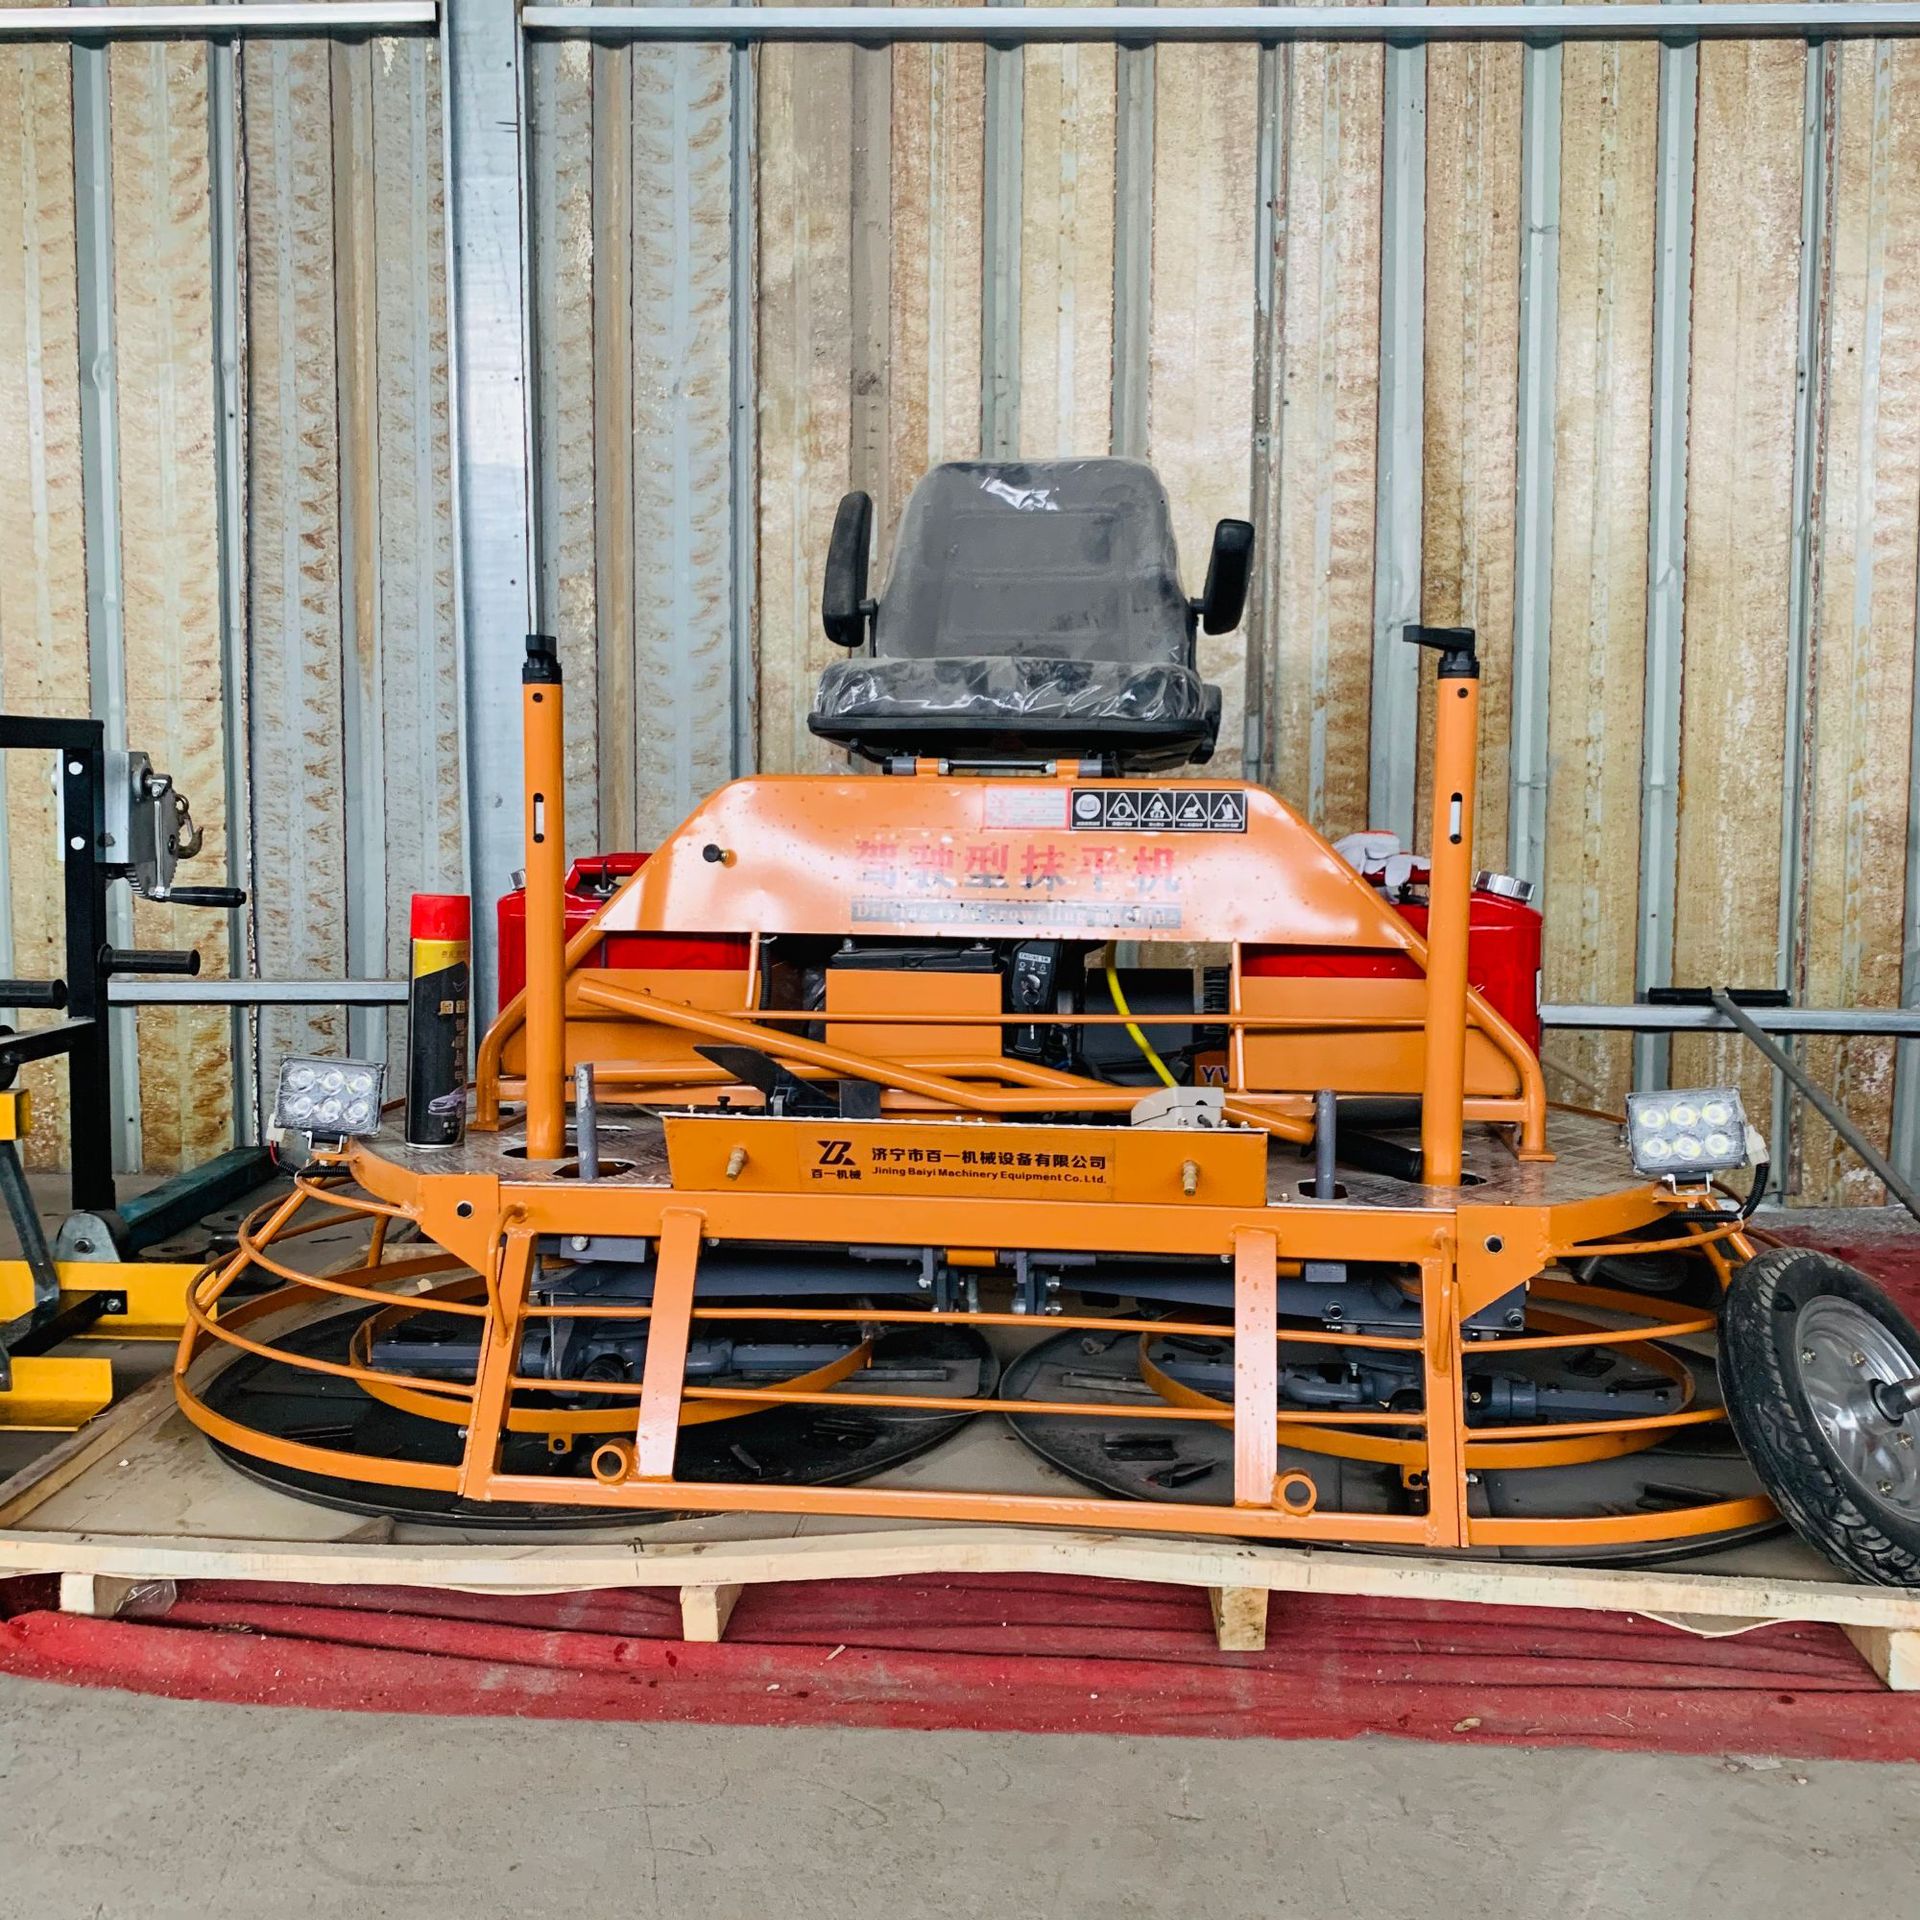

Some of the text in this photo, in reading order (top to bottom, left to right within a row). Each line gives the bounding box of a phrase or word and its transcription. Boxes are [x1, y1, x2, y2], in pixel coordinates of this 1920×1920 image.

[859, 844, 1179, 893] 驾驶型抹平机
[872, 1147, 1106, 1169] 济宁市百一机械设备有限公司
[811, 1168, 862, 1180] 百一机械
[872, 1166, 1107, 1183] Jining Baiyi Machinery Equipment Co. Ltd.
